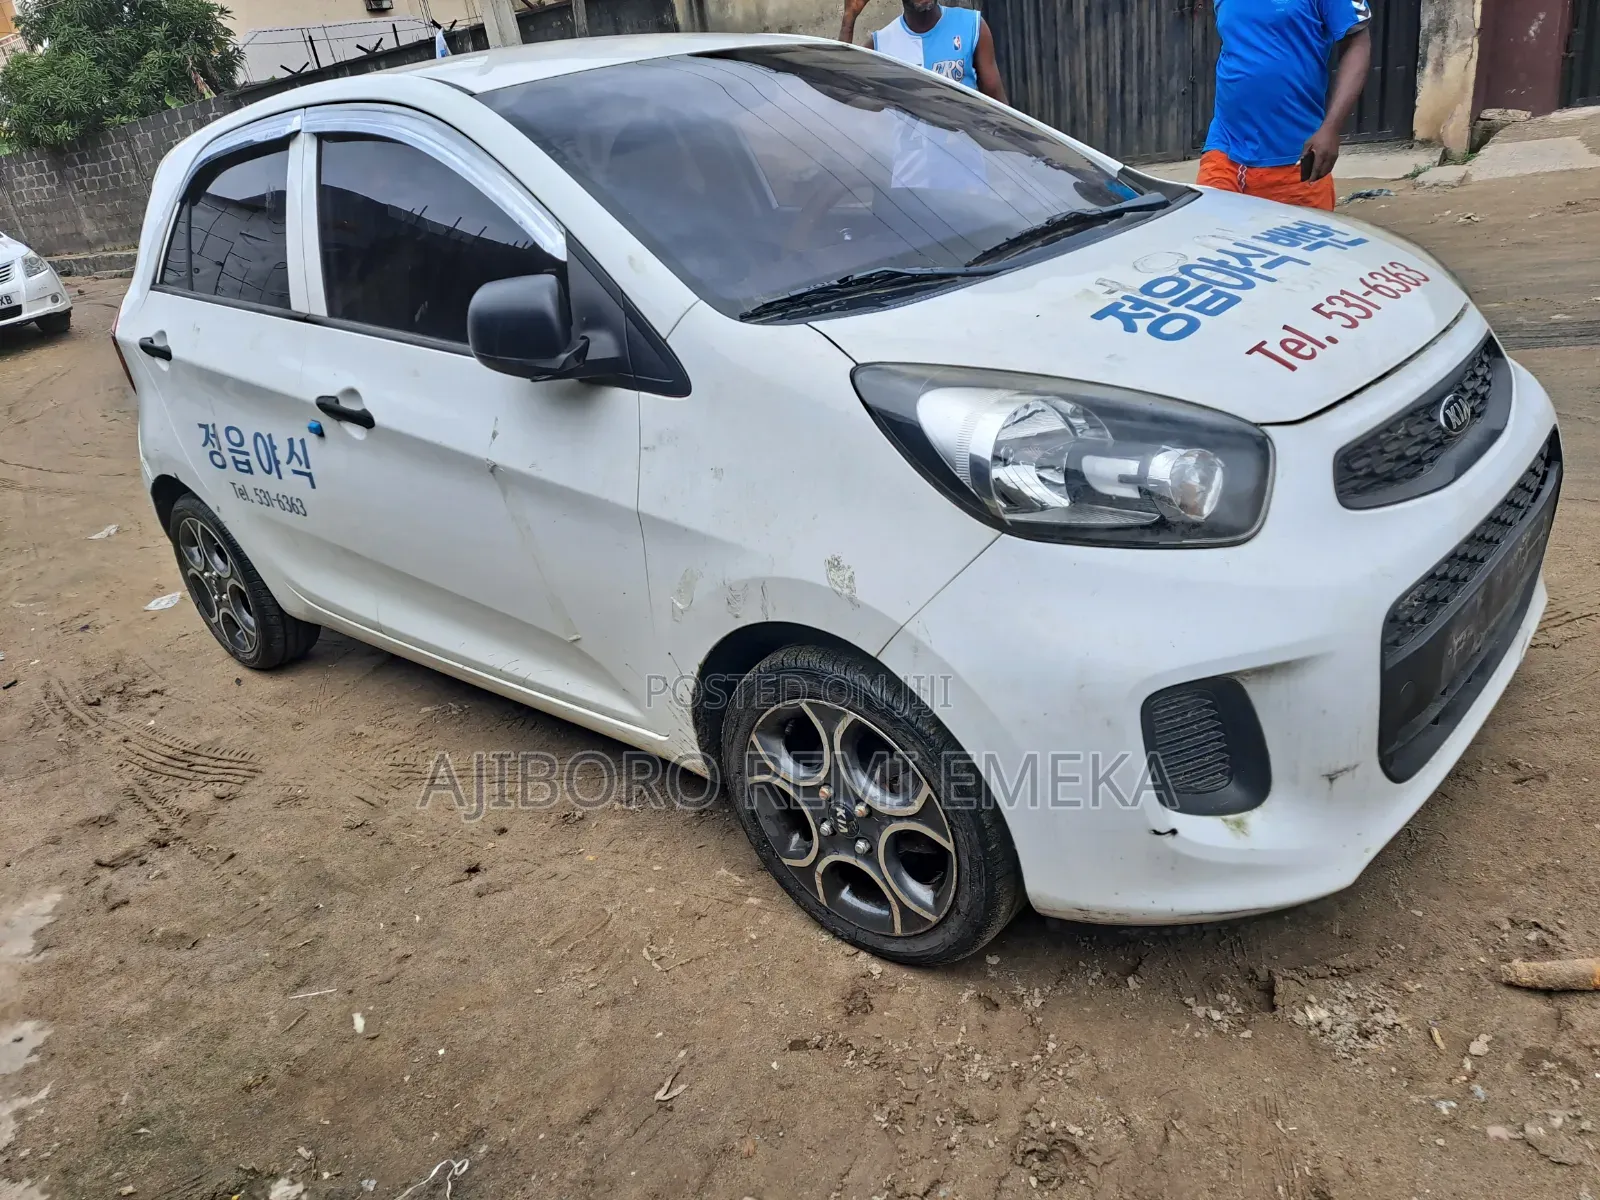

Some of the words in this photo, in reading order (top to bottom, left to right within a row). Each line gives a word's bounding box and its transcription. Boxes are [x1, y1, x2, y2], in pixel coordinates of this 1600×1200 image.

[1090, 242, 1312, 341] 정읍야식
[1251, 220, 1370, 251] 백반
[1245, 324, 1338, 372] Tel.
[1312, 261, 1431, 329] 531-6363
[1445, 398, 1470, 429] KIA
[197, 423, 316, 489] 정읍야식
[229, 482, 254, 504] Tel.
[253, 487, 307, 517] 531-6363
[836, 807, 848, 832] KIA
